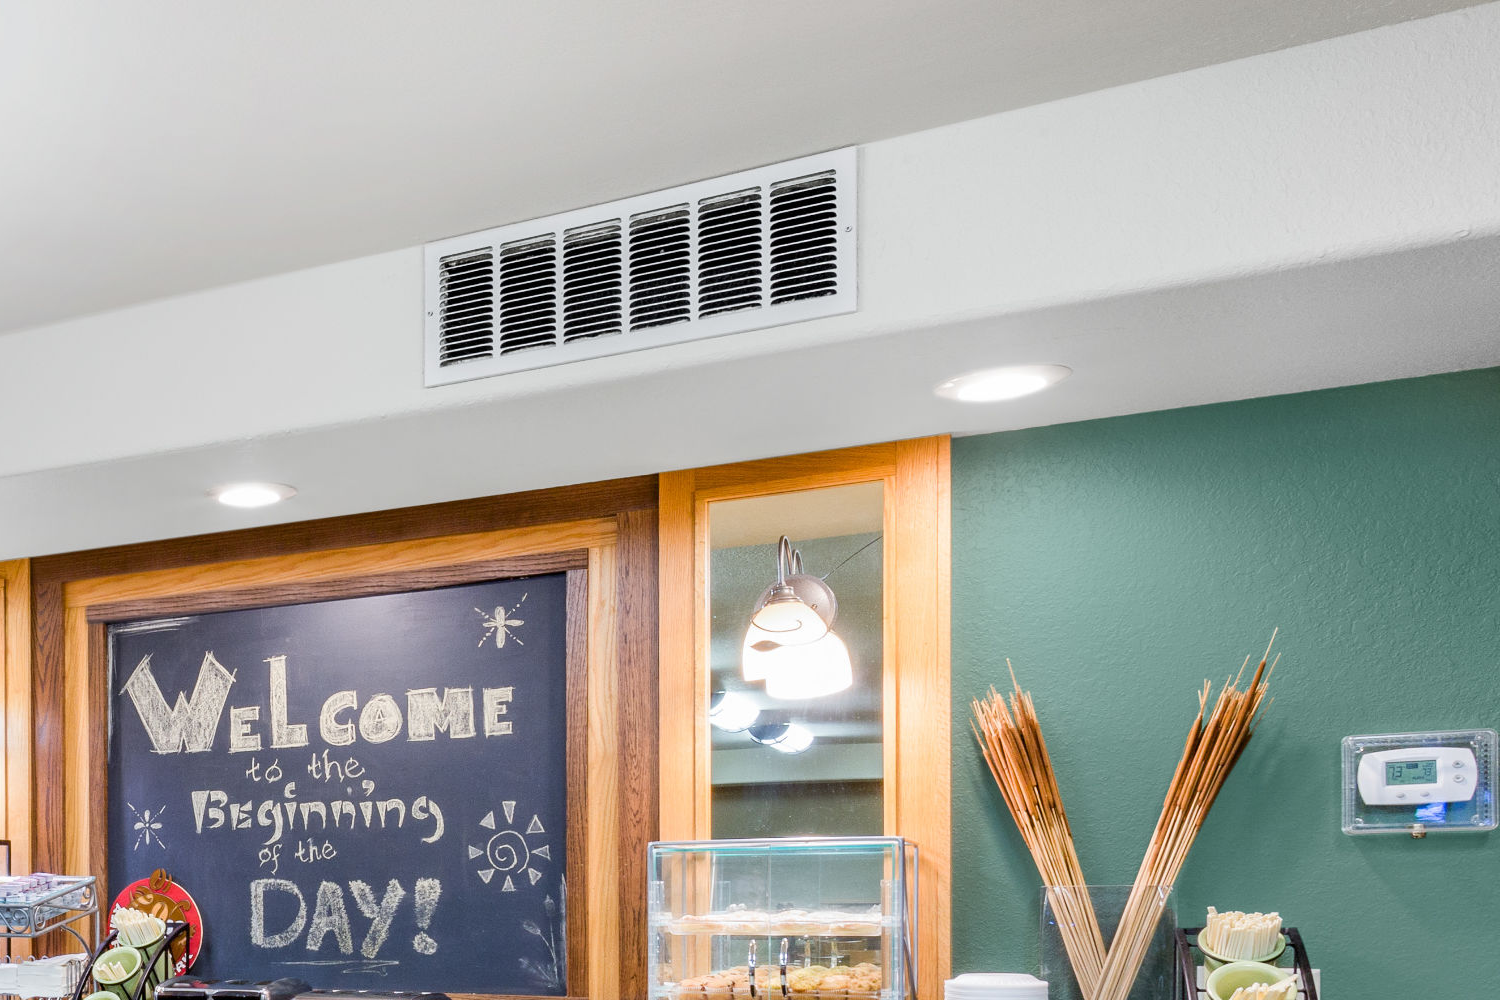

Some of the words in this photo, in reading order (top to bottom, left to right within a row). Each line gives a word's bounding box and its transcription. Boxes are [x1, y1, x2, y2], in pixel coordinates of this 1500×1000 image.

[119, 651, 515, 753] WELCOME
[246, 757, 283, 783] to
[308, 749, 366, 782] the
[258, 843, 283, 875] of
[295, 838, 338, 863] the
[250, 877, 443, 959] DAY!
